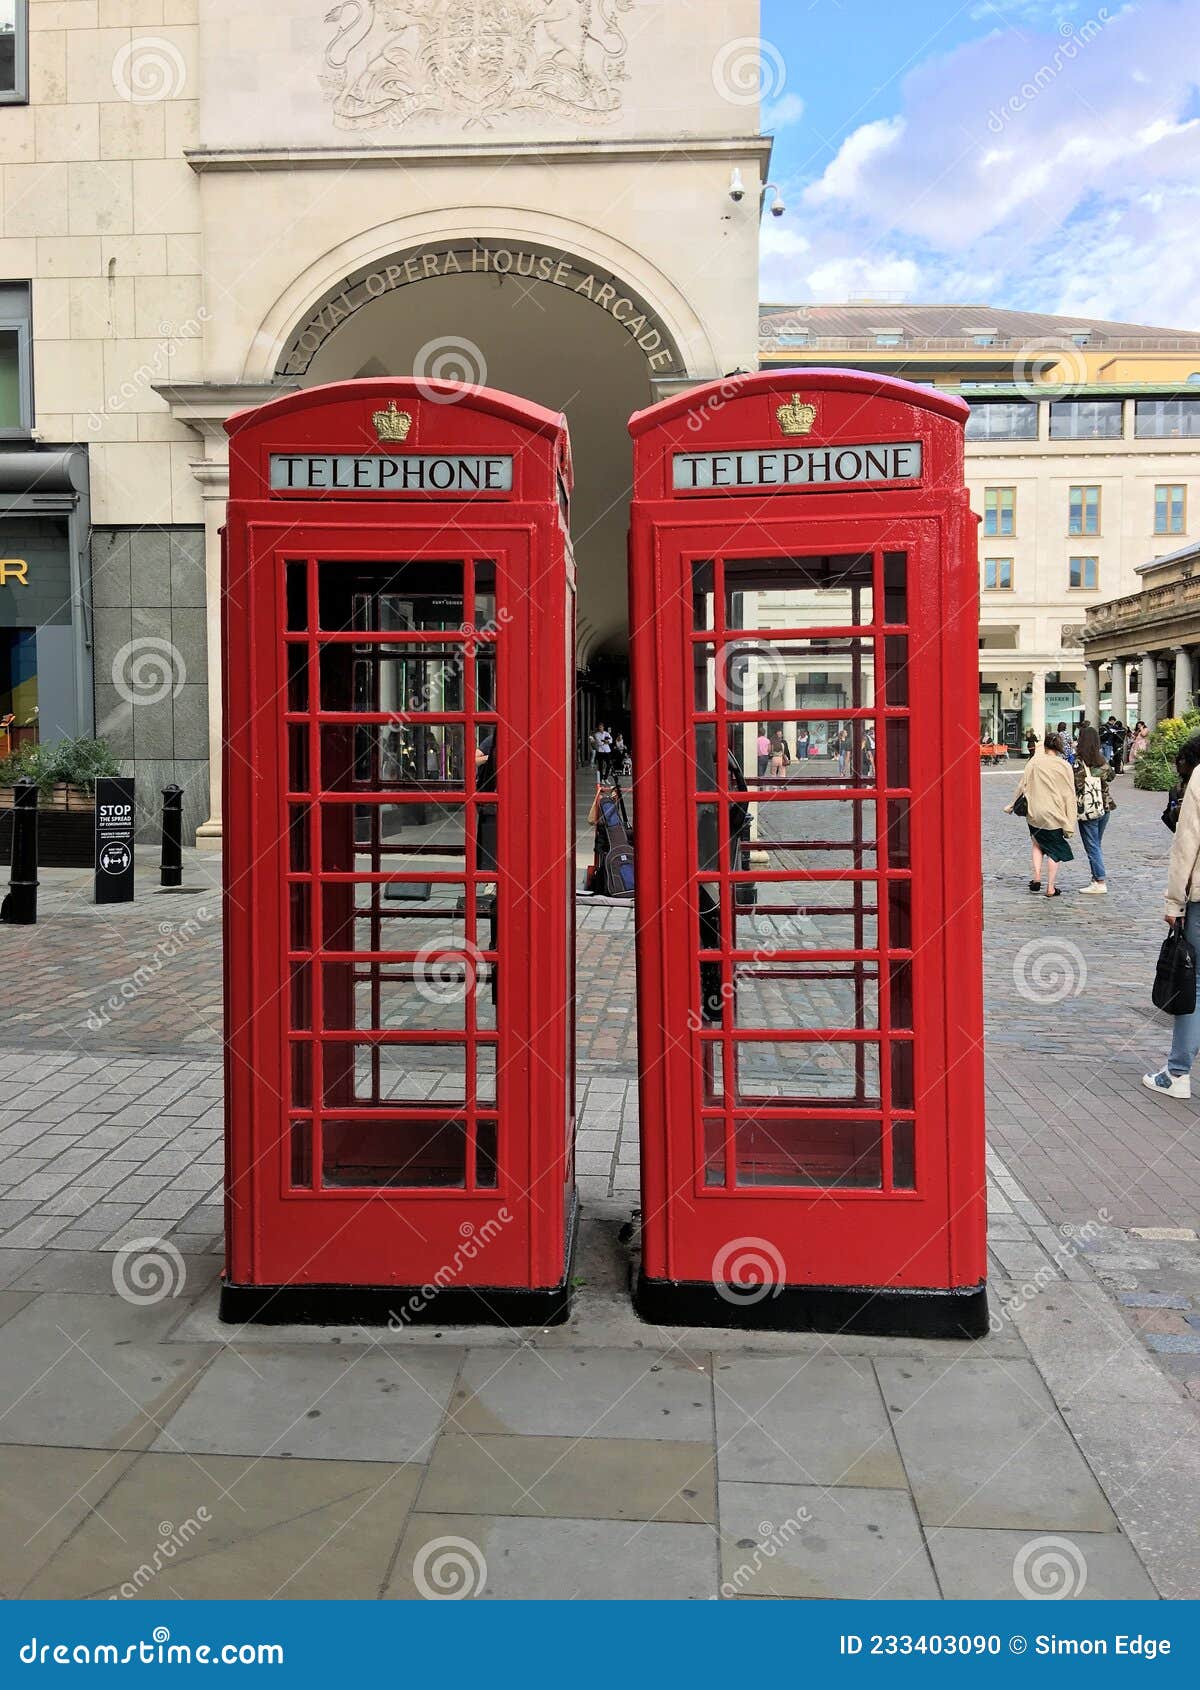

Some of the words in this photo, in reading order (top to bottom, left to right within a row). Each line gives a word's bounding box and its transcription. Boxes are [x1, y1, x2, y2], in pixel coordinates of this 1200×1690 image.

[287, 292, 364, 372] ROYAL
[365, 250, 462, 297] OPERA
[472, 248, 573, 287] HOUSE
[574, 274, 673, 370] ARCADE
[278, 457, 504, 490] TELEPHONE
[682, 448, 912, 487] TELEPHONE
[100, 804, 131, 816] STOP
